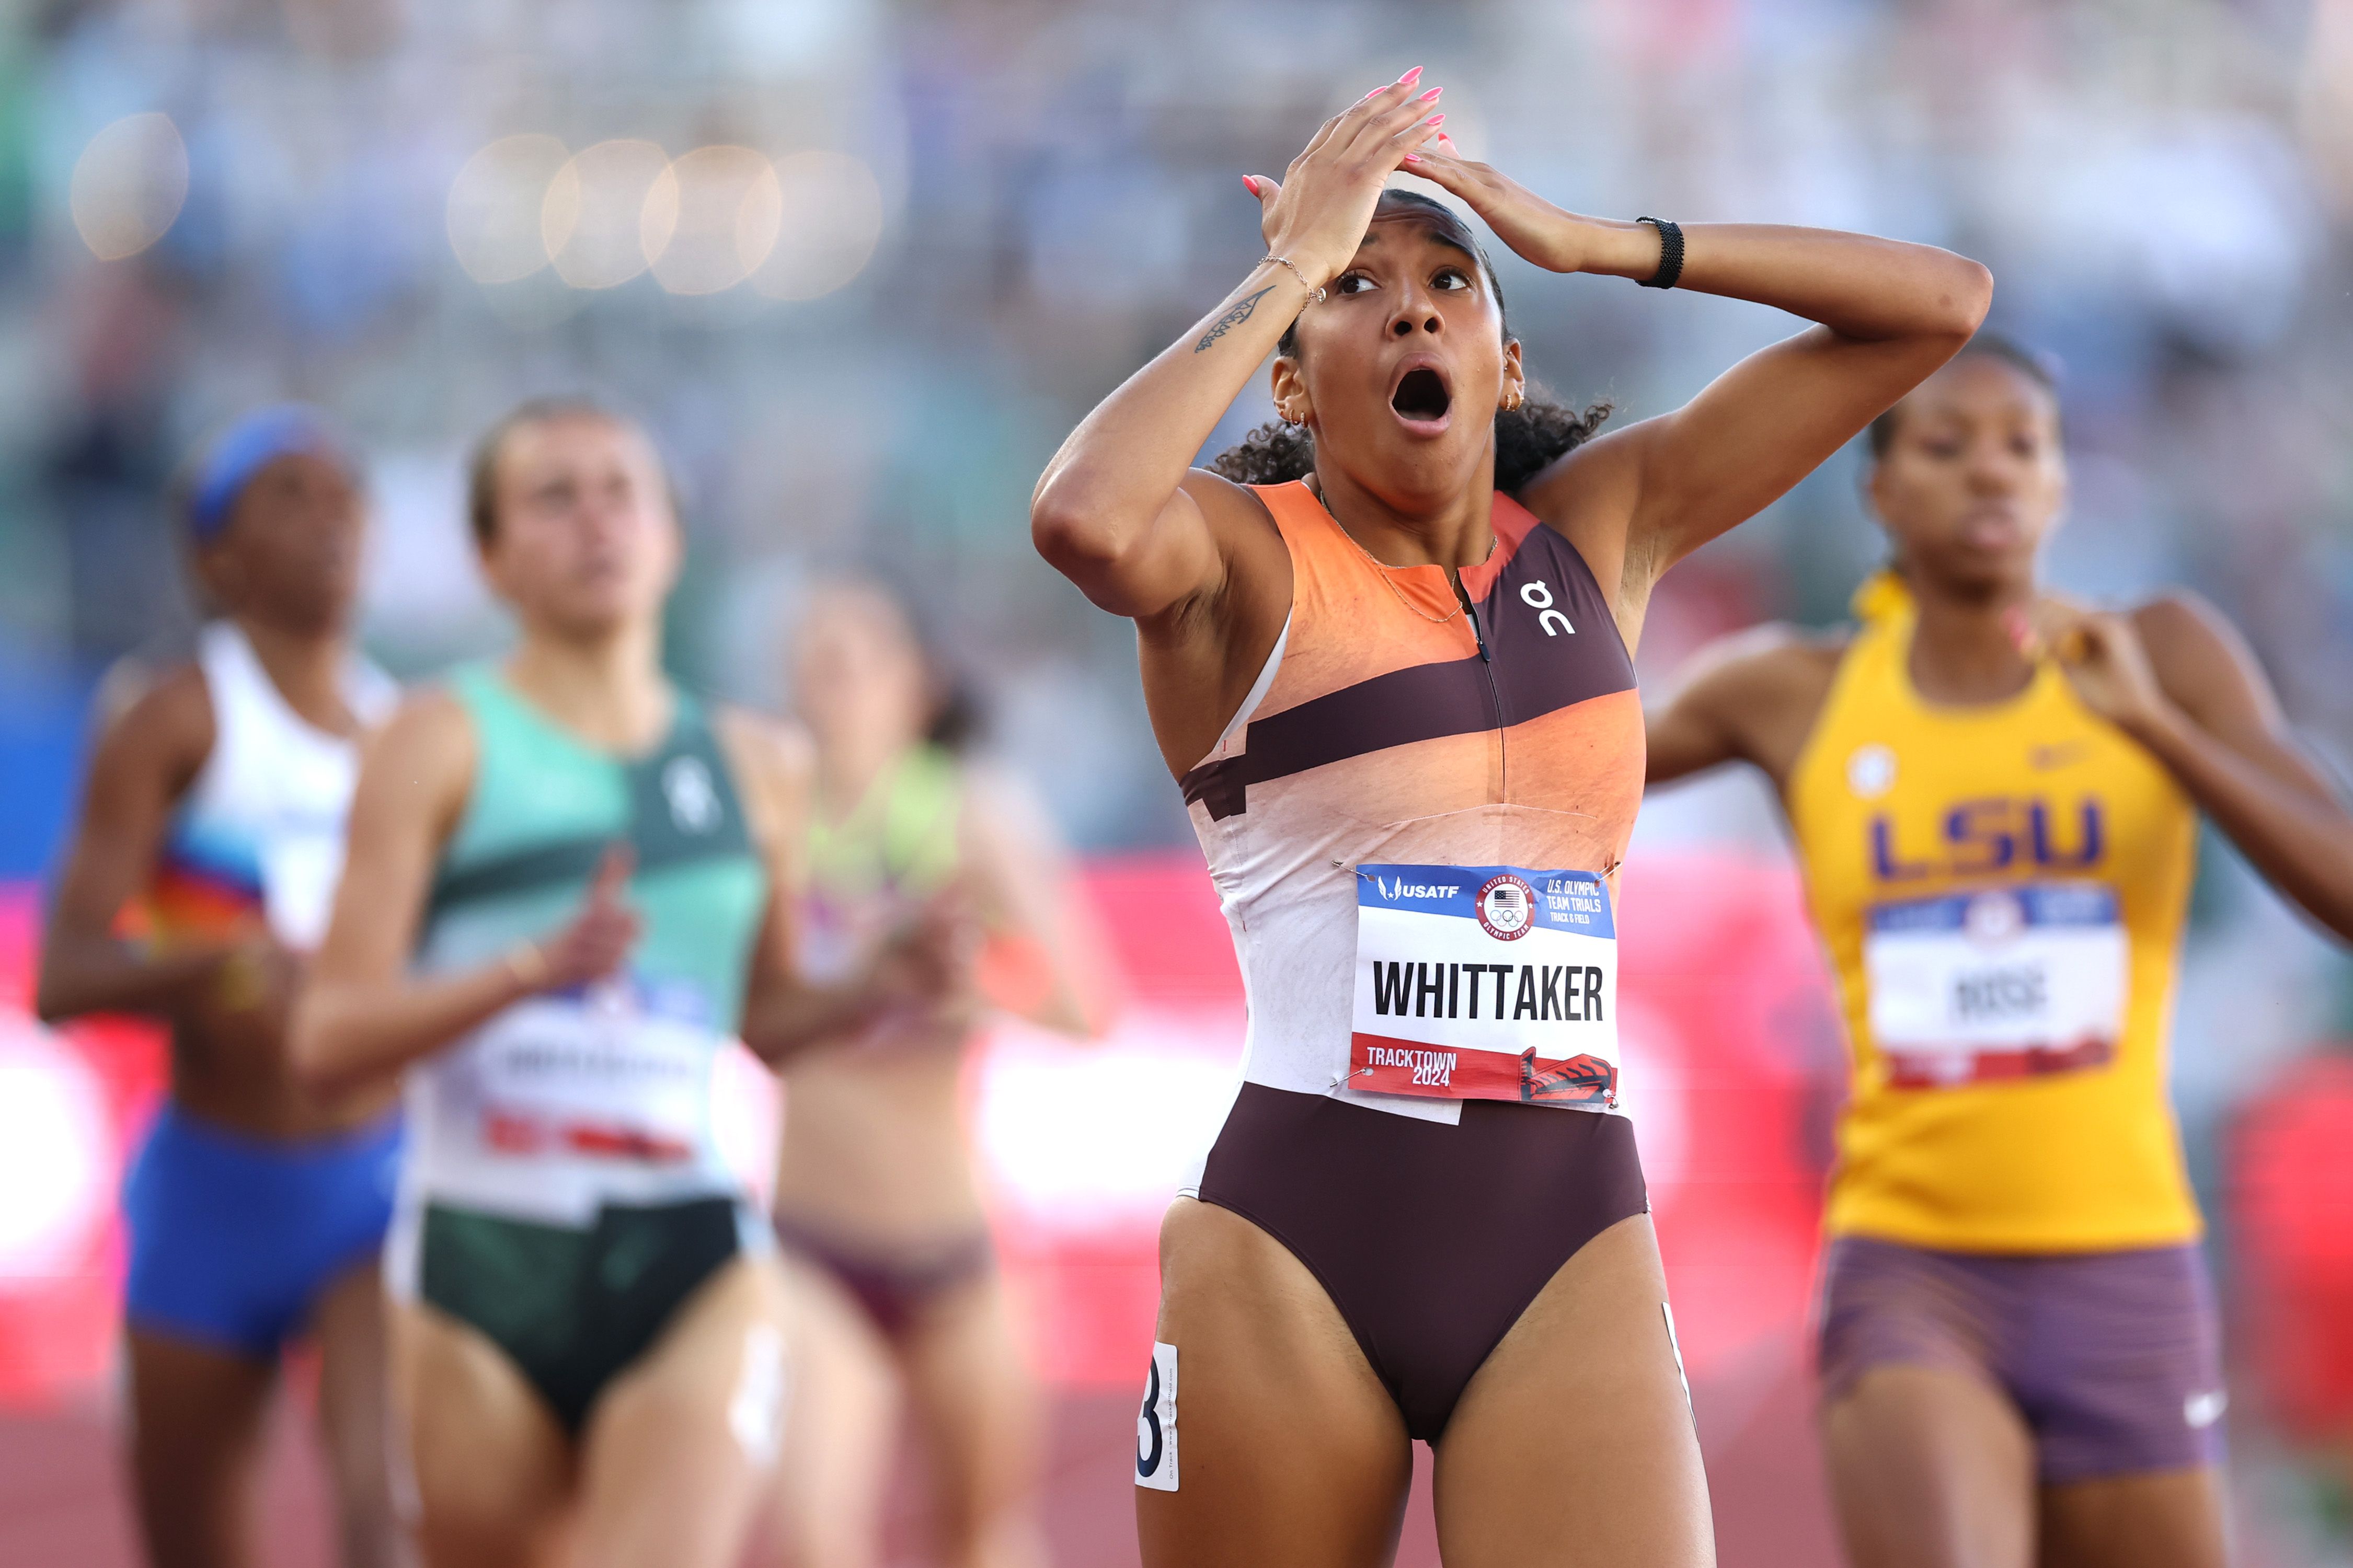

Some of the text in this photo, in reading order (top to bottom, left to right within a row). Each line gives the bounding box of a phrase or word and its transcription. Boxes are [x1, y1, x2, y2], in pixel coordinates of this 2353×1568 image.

[1869, 798, 2104, 881] LSU
[1402, 885, 1459, 898] USATF
[1482, 876, 1530, 894] UNITED STATES
[1547, 879, 1599, 896] U.S. OLYMPIC
[1546, 895, 1601, 913] TEAM TRIALS
[1550, 912, 1590, 924] TRACK & FIELD
[1484, 921, 1530, 940] OLYMPIC TEAM
[1373, 961, 1603, 1021] WHITTAKER
[1367, 1046, 1457, 1071] TRACKTOWN
[1413, 1066, 1450, 1087] 2024
[1169, 1470, 1174, 1480] On
